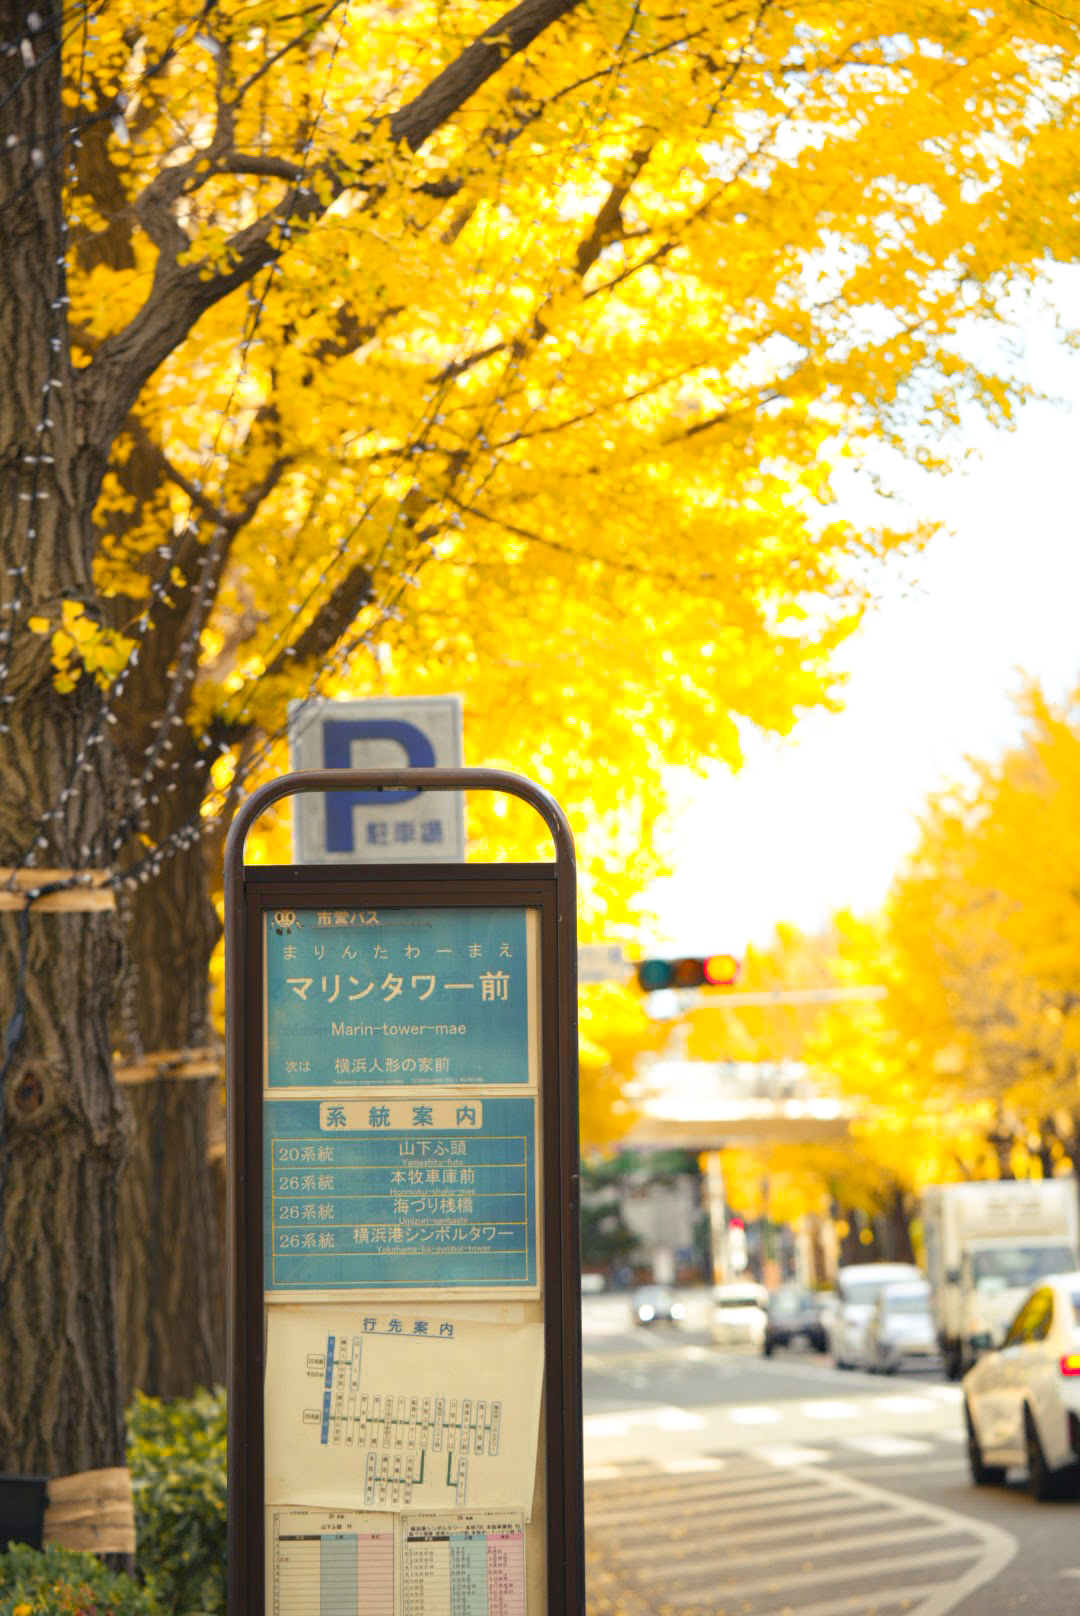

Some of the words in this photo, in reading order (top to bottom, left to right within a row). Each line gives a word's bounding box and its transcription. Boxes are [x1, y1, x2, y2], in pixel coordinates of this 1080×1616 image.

[286, 970, 511, 1003] マリンタワー前
[331, 1022, 466, 1036] Marin-tower-mae
[285, 1060, 311, 1072] 次は
[334, 1057, 450, 1073] 横浜人形の家前
[326, 1105, 476, 1128] 系統案内
[278, 1145, 335, 1161] 20系統
[399, 1140, 466, 1156] 山下ふ頭
[278, 1174, 335, 1190] 26系統
[390, 1168, 476, 1185] 本牧車庫前
[279, 1203, 335, 1220] 26系統
[393, 1197, 473, 1214] 海づり桟橋
[279, 1232, 335, 1248] 26系統
[353, 1225, 514, 1243] 横浜港シンボルタワー
[363, 1317, 454, 1336] 行先案内
